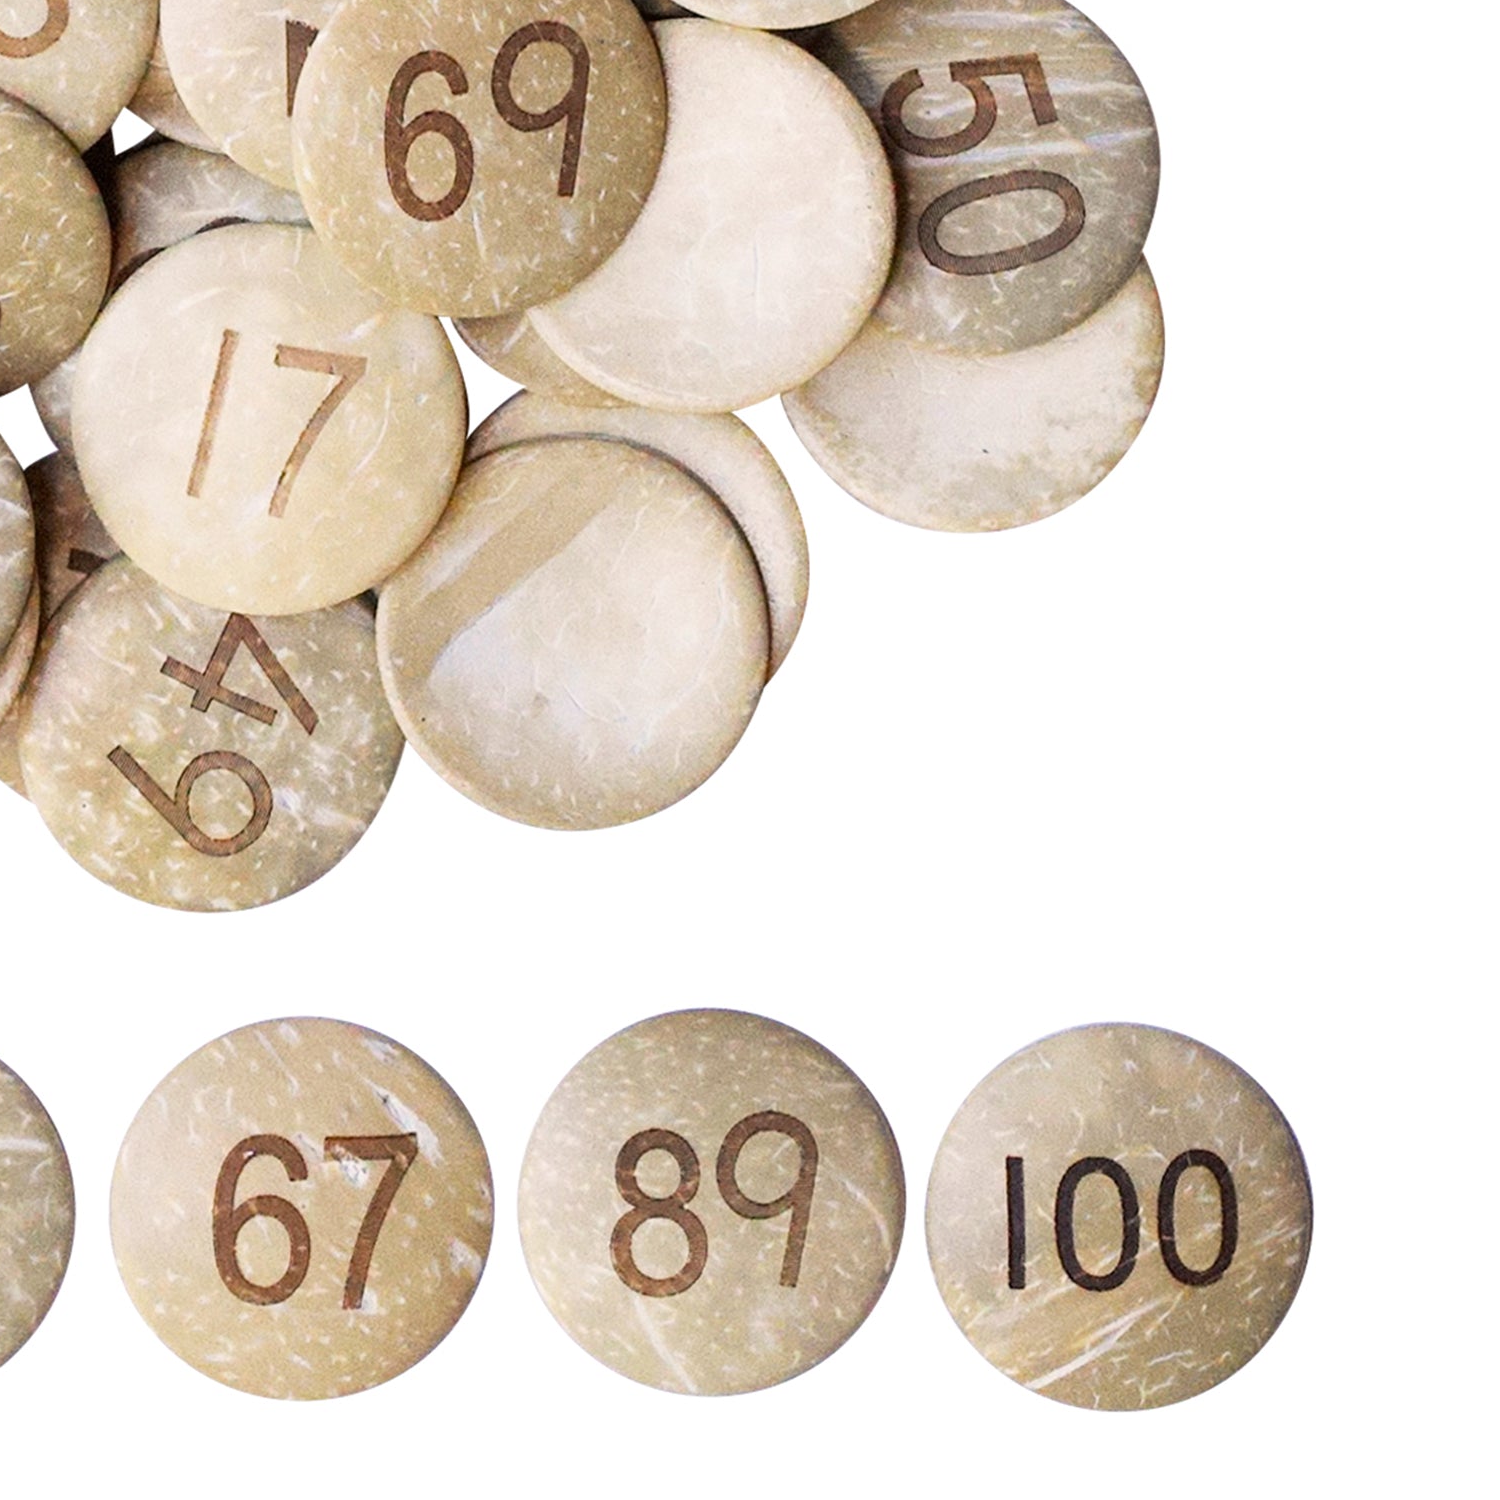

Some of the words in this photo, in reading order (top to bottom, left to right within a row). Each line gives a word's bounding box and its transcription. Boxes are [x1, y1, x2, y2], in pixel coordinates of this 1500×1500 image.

[383, 20, 592, 222] 69
[880, 52, 1087, 277] 50
[186, 329, 368, 518] 17
[107, 612, 319, 858] 49
[212, 1131, 420, 1310] 67
[610, 1109, 820, 1297] 89
[1005, 1147, 1240, 1294] 100
